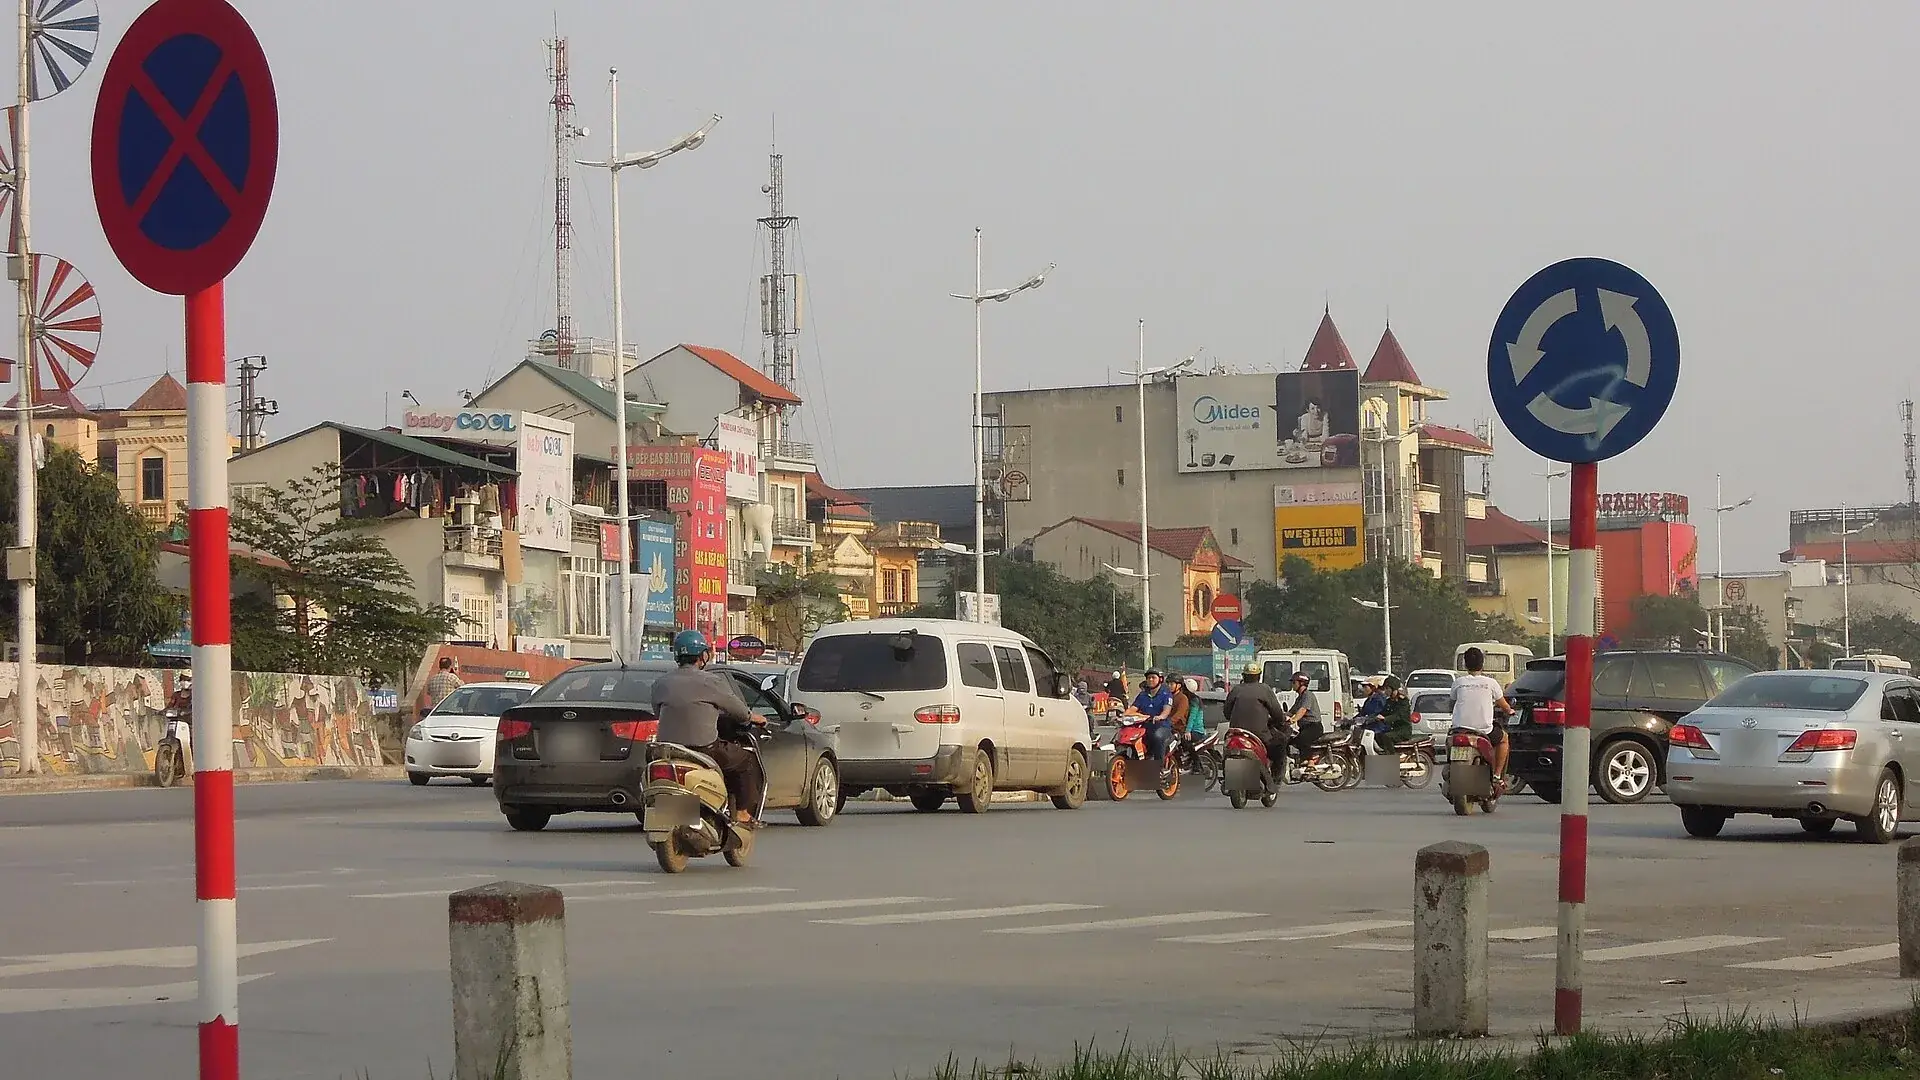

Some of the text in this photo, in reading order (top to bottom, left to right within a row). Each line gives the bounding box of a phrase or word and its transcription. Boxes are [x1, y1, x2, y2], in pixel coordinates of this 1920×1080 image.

[1201, 402, 1260, 422] Midea
[650, 452, 664, 465] GAS
[669, 487, 689, 504] GAS
[1284, 528, 1342, 539] WESTERN
[1303, 537, 1343, 547] UNION
[675, 537, 688, 557] ẾP
[695, 550, 704, 565] GAS
[717, 552, 725, 568] GAS
[675, 568, 689, 585] AS
[675, 588, 689, 612] ẢO
